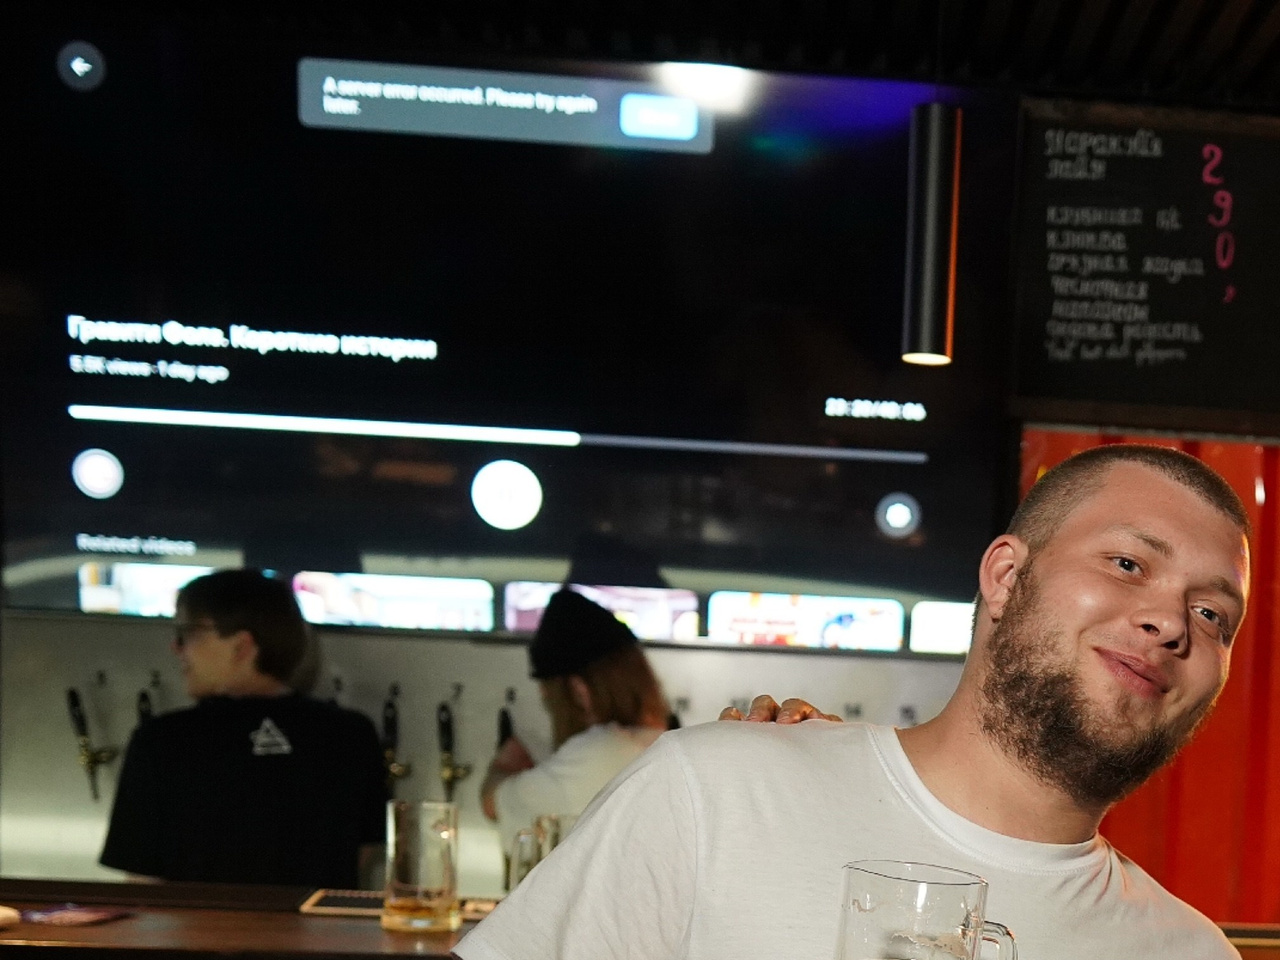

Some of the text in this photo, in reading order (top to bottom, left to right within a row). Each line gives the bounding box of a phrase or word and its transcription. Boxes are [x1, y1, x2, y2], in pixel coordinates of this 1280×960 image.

[323, 77, 337, 95] A
[76, 532, 197, 556] Related videos
